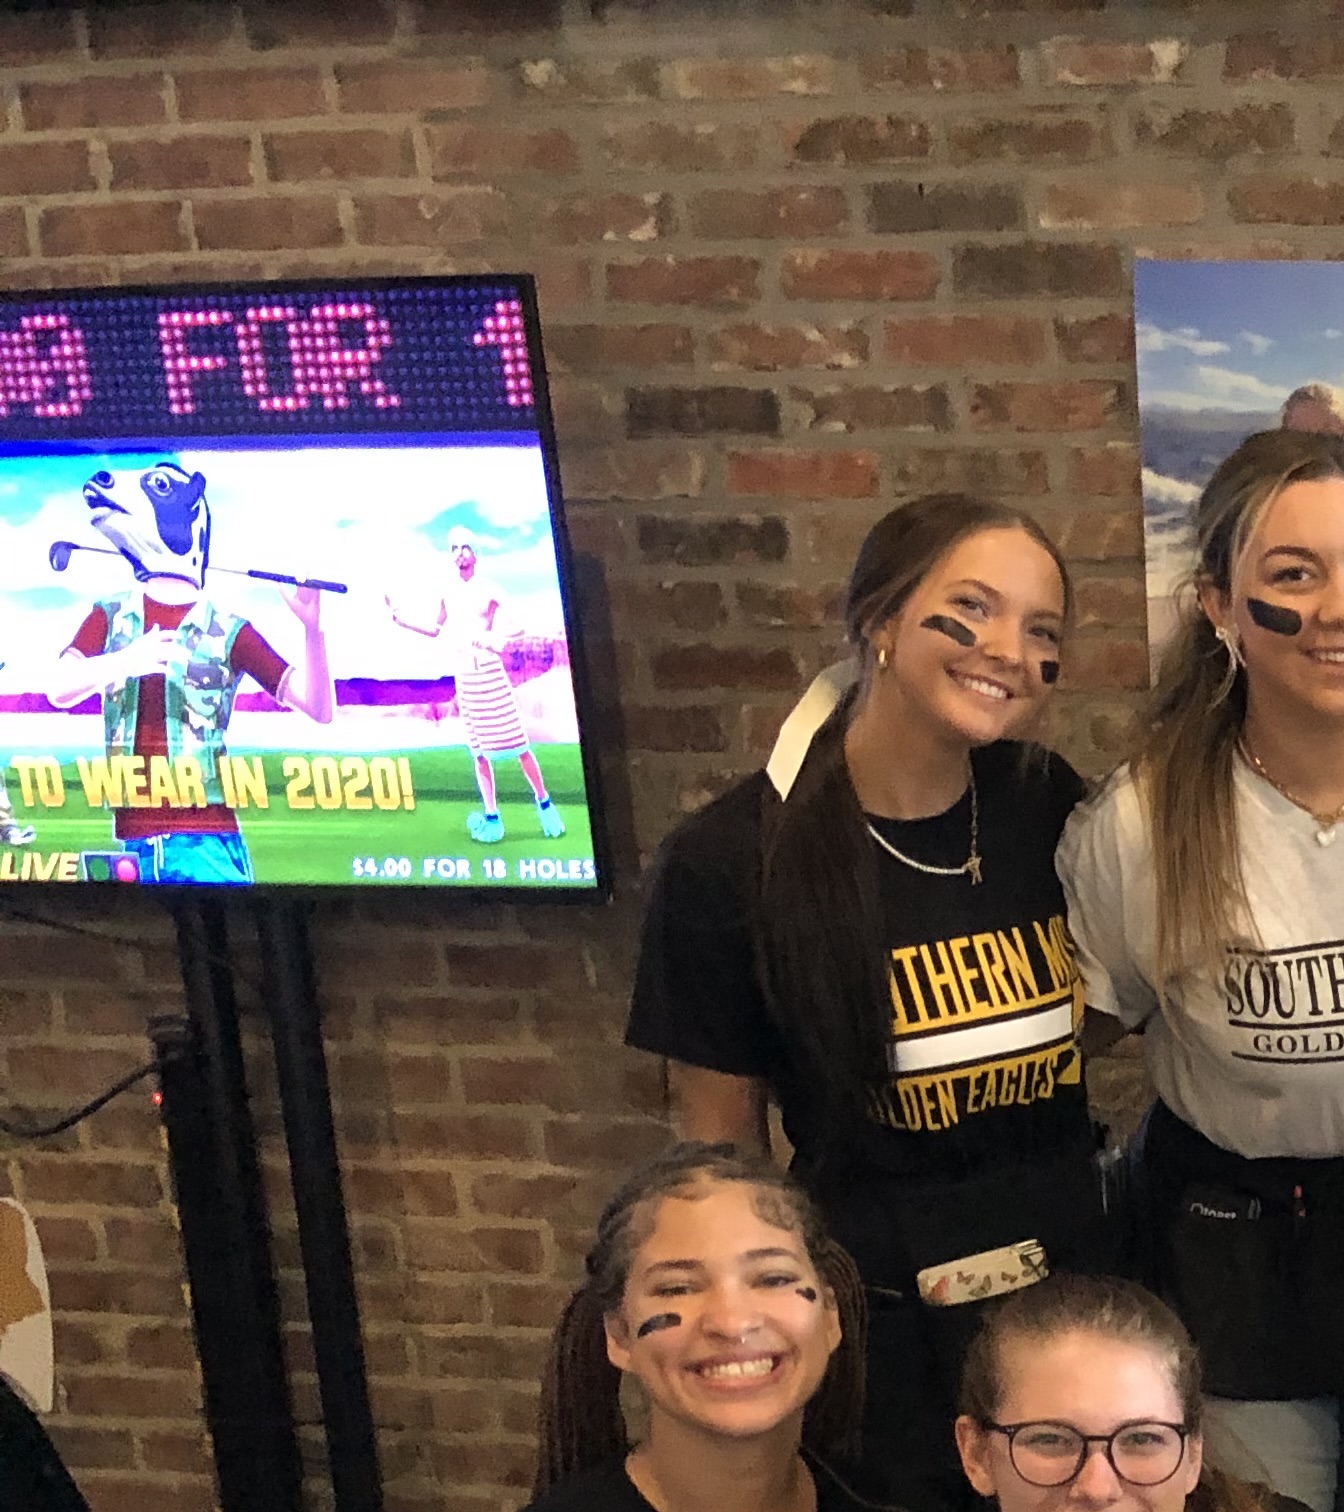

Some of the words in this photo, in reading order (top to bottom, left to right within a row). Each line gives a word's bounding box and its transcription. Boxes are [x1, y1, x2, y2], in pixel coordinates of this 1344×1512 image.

[157, 303, 401, 415] FOR
[11, 756, 65, 807] TO
[77, 756, 207, 809] WEAR
[217, 756, 269, 809] IN
[282, 756, 416, 811] 2020!
[1, 852, 80, 882] LIVE
[353, 857, 412, 878] $4.00
[423, 858, 471, 879] FOR
[519, 858, 597, 880] HOLES
[966, 1056, 1059, 1114] EAGLES
